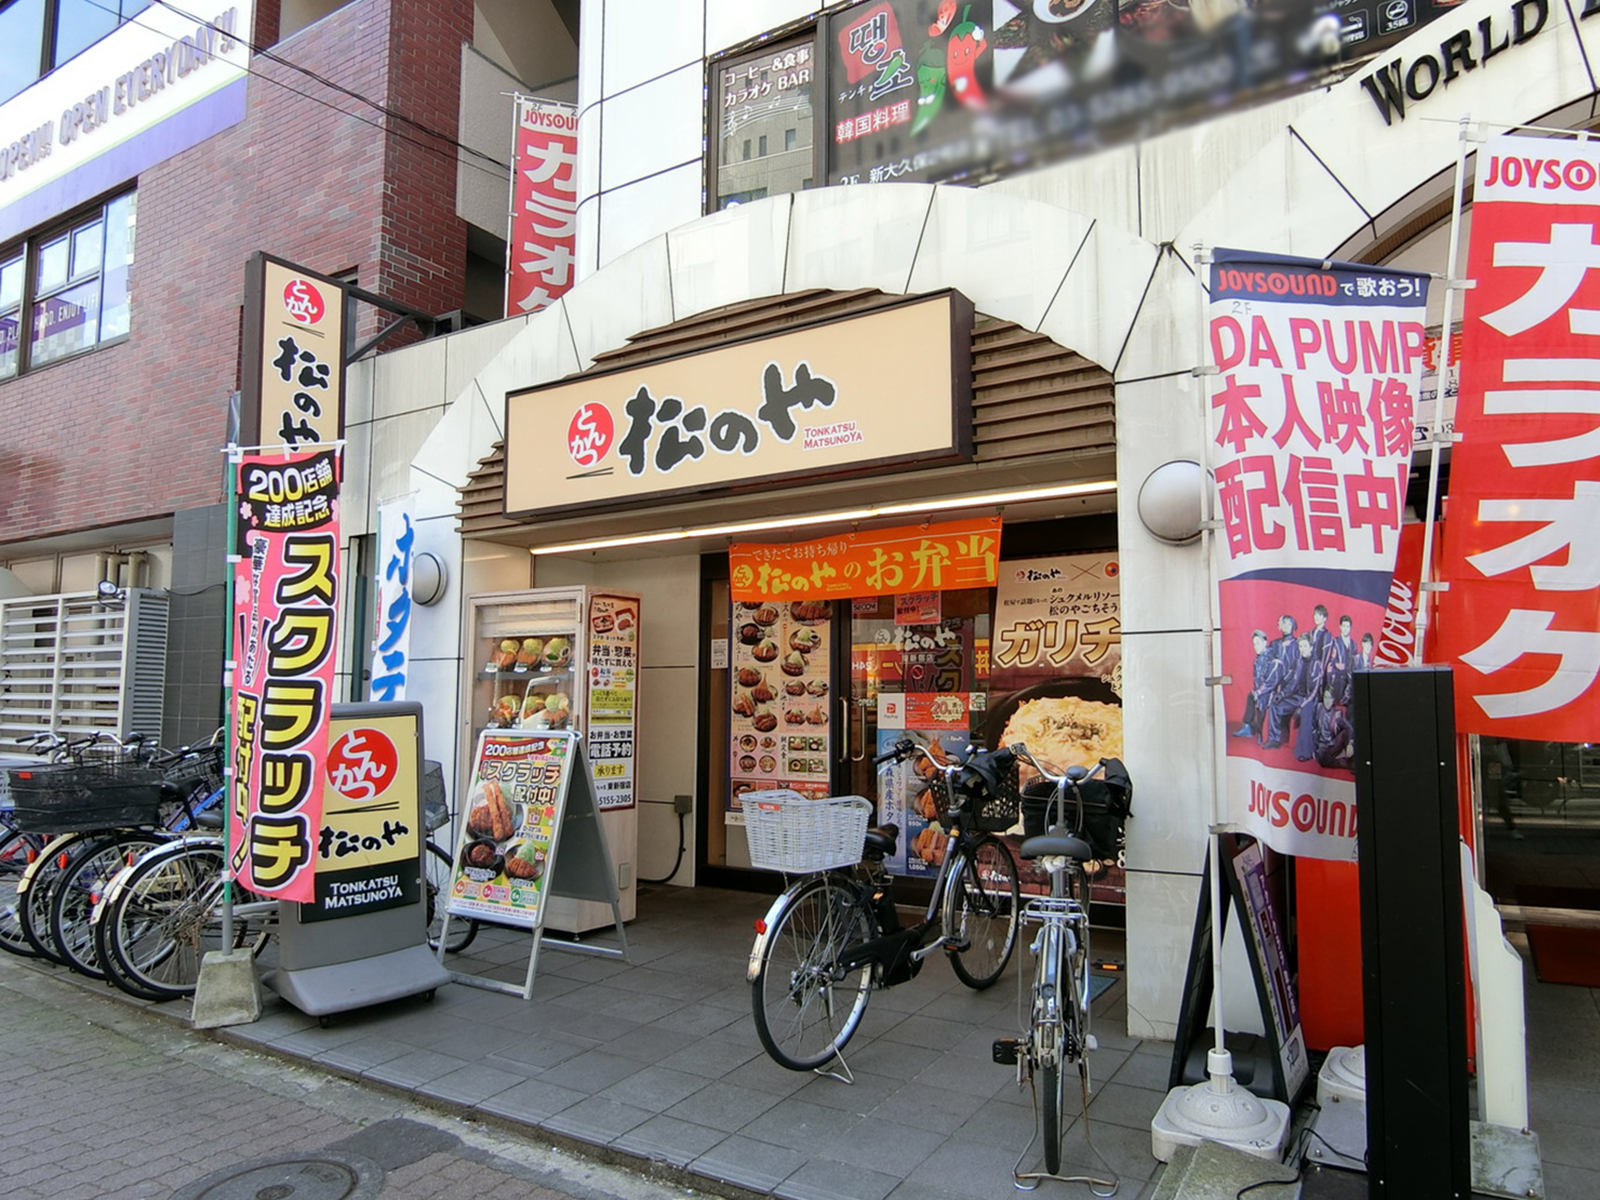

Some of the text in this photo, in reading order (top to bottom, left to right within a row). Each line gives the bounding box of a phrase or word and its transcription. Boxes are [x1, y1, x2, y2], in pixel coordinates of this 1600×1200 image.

[1360, 0, 1549, 126] WORLD
[724, 69, 811, 108] カラオケ BAR
[59, 85, 110, 146] OPEN
[523, 109, 578, 131] JOYSOU
[836, 100, 911, 144] 韓国料理
[1484, 156, 1600, 192] JOYSO
[1217, 269, 1421, 298] JOYSOUND で歌おう!
[1210, 315, 1283, 373] DA
[1289, 317, 1426, 375] PUMP
[272, 335, 331, 452] 松のや
[618, 363, 836, 475] 松のや
[804, 421, 856, 439] TONKATSU
[1211, 373, 1416, 458] 本人映像
[570, 405, 607, 467] とんかつ
[803, 431, 863, 449] MATSUNOYA
[248, 457, 334, 503] 200店舗
[263, 493, 331, 528] 達成記念
[752, 541, 848, 562] できたてお持ち帰り
[853, 603, 876, 612] SECOM
[892, 626, 957, 652] 松のや
[997, 616, 1121, 666] ガリチ
[250, 534, 334, 888] スクラッチ
[590, 742, 632, 758] 電話予約
[486, 761, 562, 785] スクラッチ
[318, 820, 410, 859] 松のや
[325, 886, 404, 909] MATSUNOYA
[330, 875, 399, 895] TONKATSU
